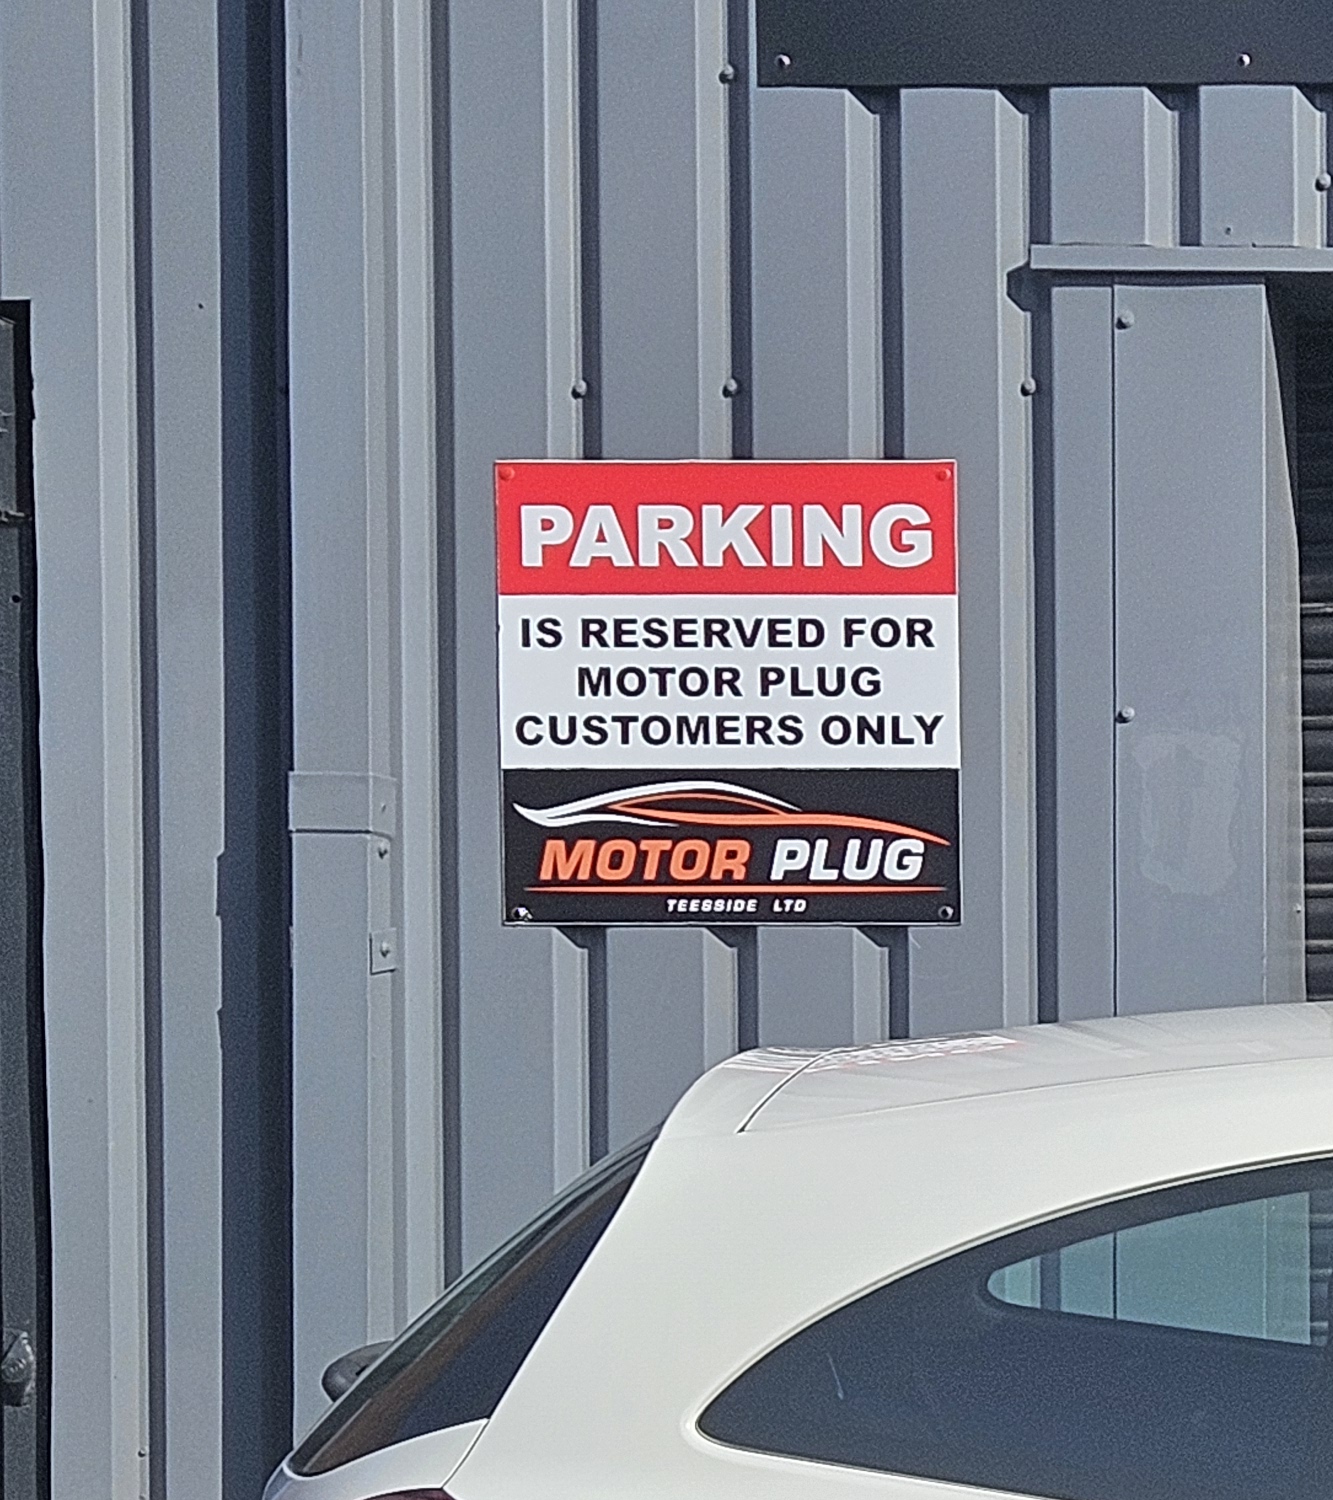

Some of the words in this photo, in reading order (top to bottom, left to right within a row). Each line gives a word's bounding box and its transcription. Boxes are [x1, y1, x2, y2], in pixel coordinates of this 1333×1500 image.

[520, 503, 934, 568] PARKING
[521, 618, 563, 648] IS
[581, 618, 825, 648] RESERVED
[844, 618, 935, 648] FOR
[577, 667, 742, 697] MOTOR
[760, 667, 882, 697] PLUG
[515, 715, 804, 746] CUSTOMERS
[821, 715, 944, 745] ONLY
[538, 838, 751, 881] MOTOR
[770, 838, 925, 881] PLUG
[666, 899, 758, 913] TEESSIDE
[773, 899, 807, 913] LTD
